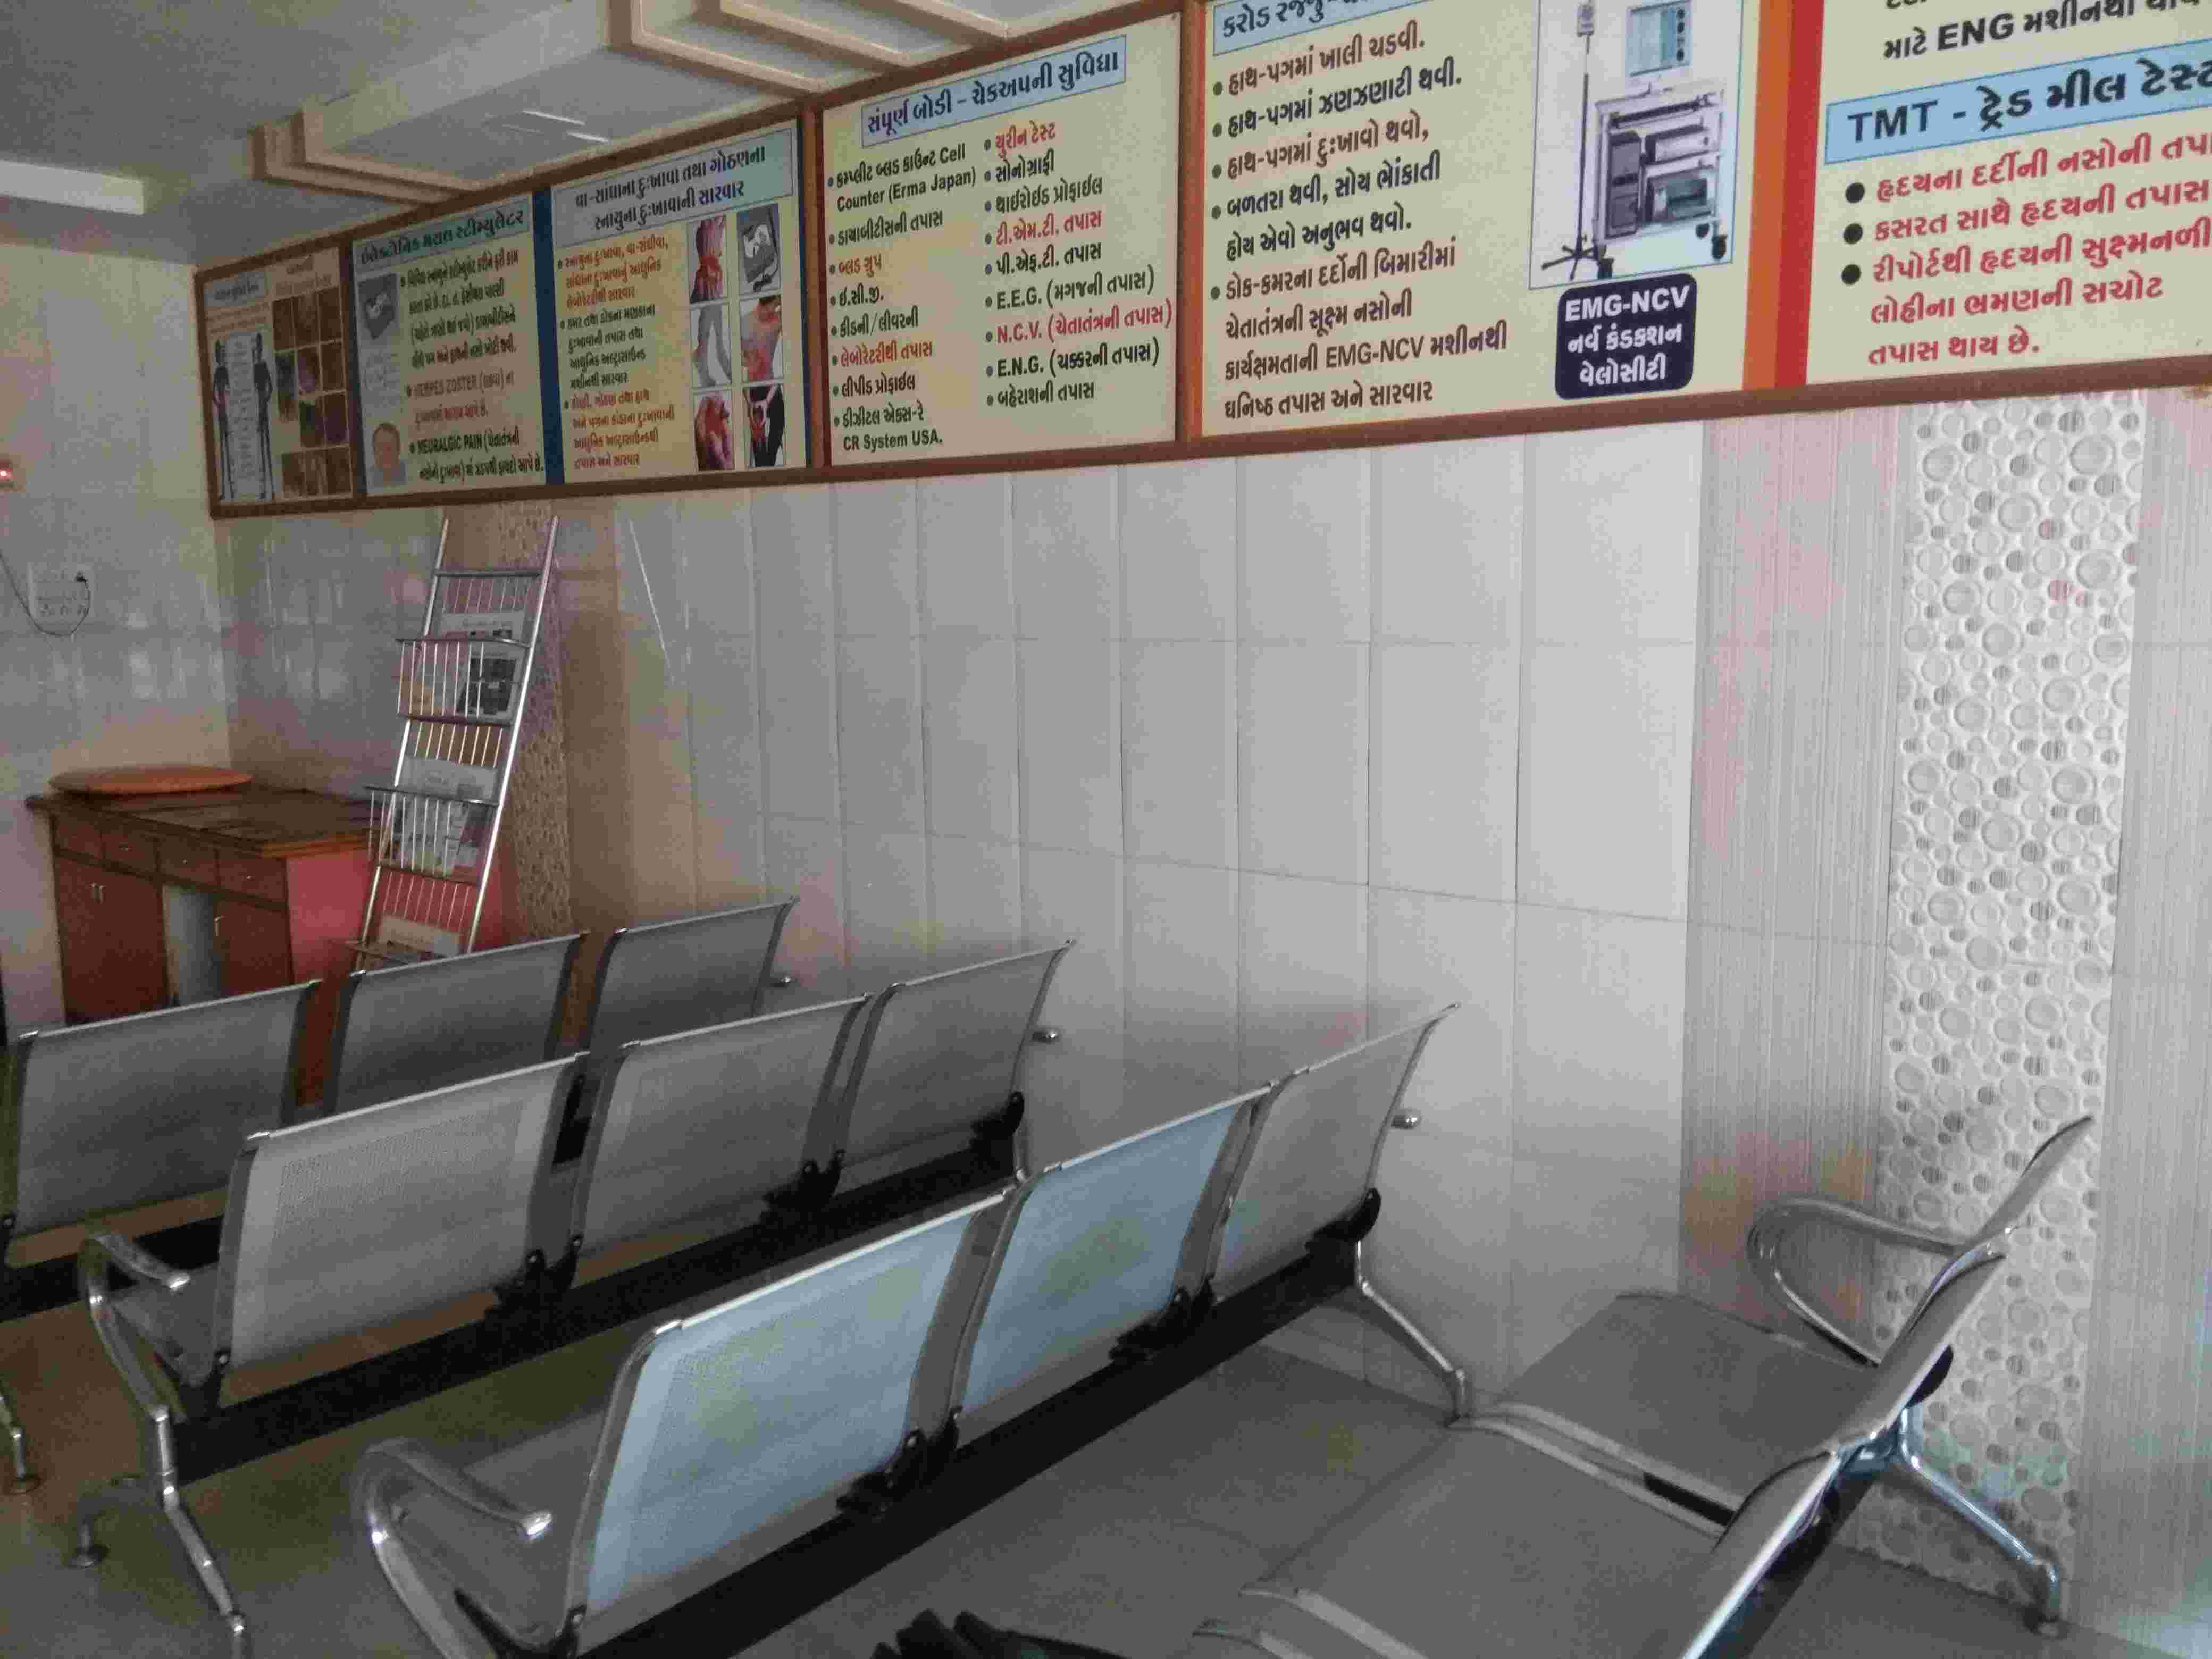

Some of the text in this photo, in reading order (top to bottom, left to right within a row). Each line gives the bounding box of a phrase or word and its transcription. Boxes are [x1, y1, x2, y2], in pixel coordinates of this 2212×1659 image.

[1228, 20, 1425, 96] હાથ-પગમાં ખાલી ચડવી.
[1883, 26, 1928, 60] માટે
[1937, 14, 2015, 51] ENG
[914, 88, 952, 120] બોડી
[1058, 49, 1118, 90] સુવિધા
[1228, 88, 1313, 138] હાથ-પગમાં
[1418, 56, 1462, 91] થવી.
[1847, 100, 1938, 144] TMT
[2046, 67, 2126, 110] મીલ
[1029, 120, 1055, 143] ટેસ્ટ
[1227, 131, 1311, 180] હાથ-પગમાં
[1386, 108, 1429, 143] થવો,
[940, 143, 965, 164] Cell
[2057, 132, 2152, 174] નસોની
[698, 181, 744, 205] સારવાર
[837, 166, 976, 212] Counter (Erma Japan)
[1227, 189, 1283, 217] બળતરા
[1289, 174, 1328, 205] થવી,
[1335, 167, 1370, 197] સોય
[910, 210, 943, 231] તપાસ
[1063, 210, 1101, 233] તપાસ
[1226, 200, 1412, 261] હોય એવો અનુભવ થવો.
[1874, 213, 1947, 242] કસરત
[1956, 197, 2010, 231] સાથે
[2125, 179, 2209, 211] તપાસ
[1063, 242, 1101, 265] તપાસ
[1226, 267, 1313, 300] ડોક-કમરના
[1374, 236, 1456, 278] બિમારીમાં
[1872, 244, 1971, 283] રીપોર્ટથી
[996, 286, 1042, 309] E.E.G.
[1107, 263, 1154, 295] તપાસ)
[1565, 285, 1690, 322] EMG-NCV
[1870, 292, 1955, 325] લોહીના
[2081, 269, 2164, 304] સચોટ
[996, 321, 1042, 343] N.C.V.
[1124, 298, 1172, 329] તપાસ)
[1226, 304, 1303, 340] ચેતાતંત્રની
[1354, 288, 1412, 323] નસોની
[901, 341, 932, 359] તપાસ
[997, 355, 1044, 378] E.N.G.
[1112, 336, 1159, 367] તપાસ)
[1225, 320, 1506, 381] કાર્યક્ષમતાની EMG-NCV મશીનથી
[1568, 325, 1602, 353] નર્વ
[1867, 324, 2040, 366] તપાસ થાય છે.
[842, 375, 872, 397] લીપીડ
[1579, 352, 1666, 387] વેલોસીટી
[1058, 381, 1094, 401] તપાસ
[1278, 391, 1325, 414] તપાસ
[1331, 379, 1363, 409] અને
[1369, 381, 1433, 407] સારવાર
[843, 428, 943, 453] CR System USA.
